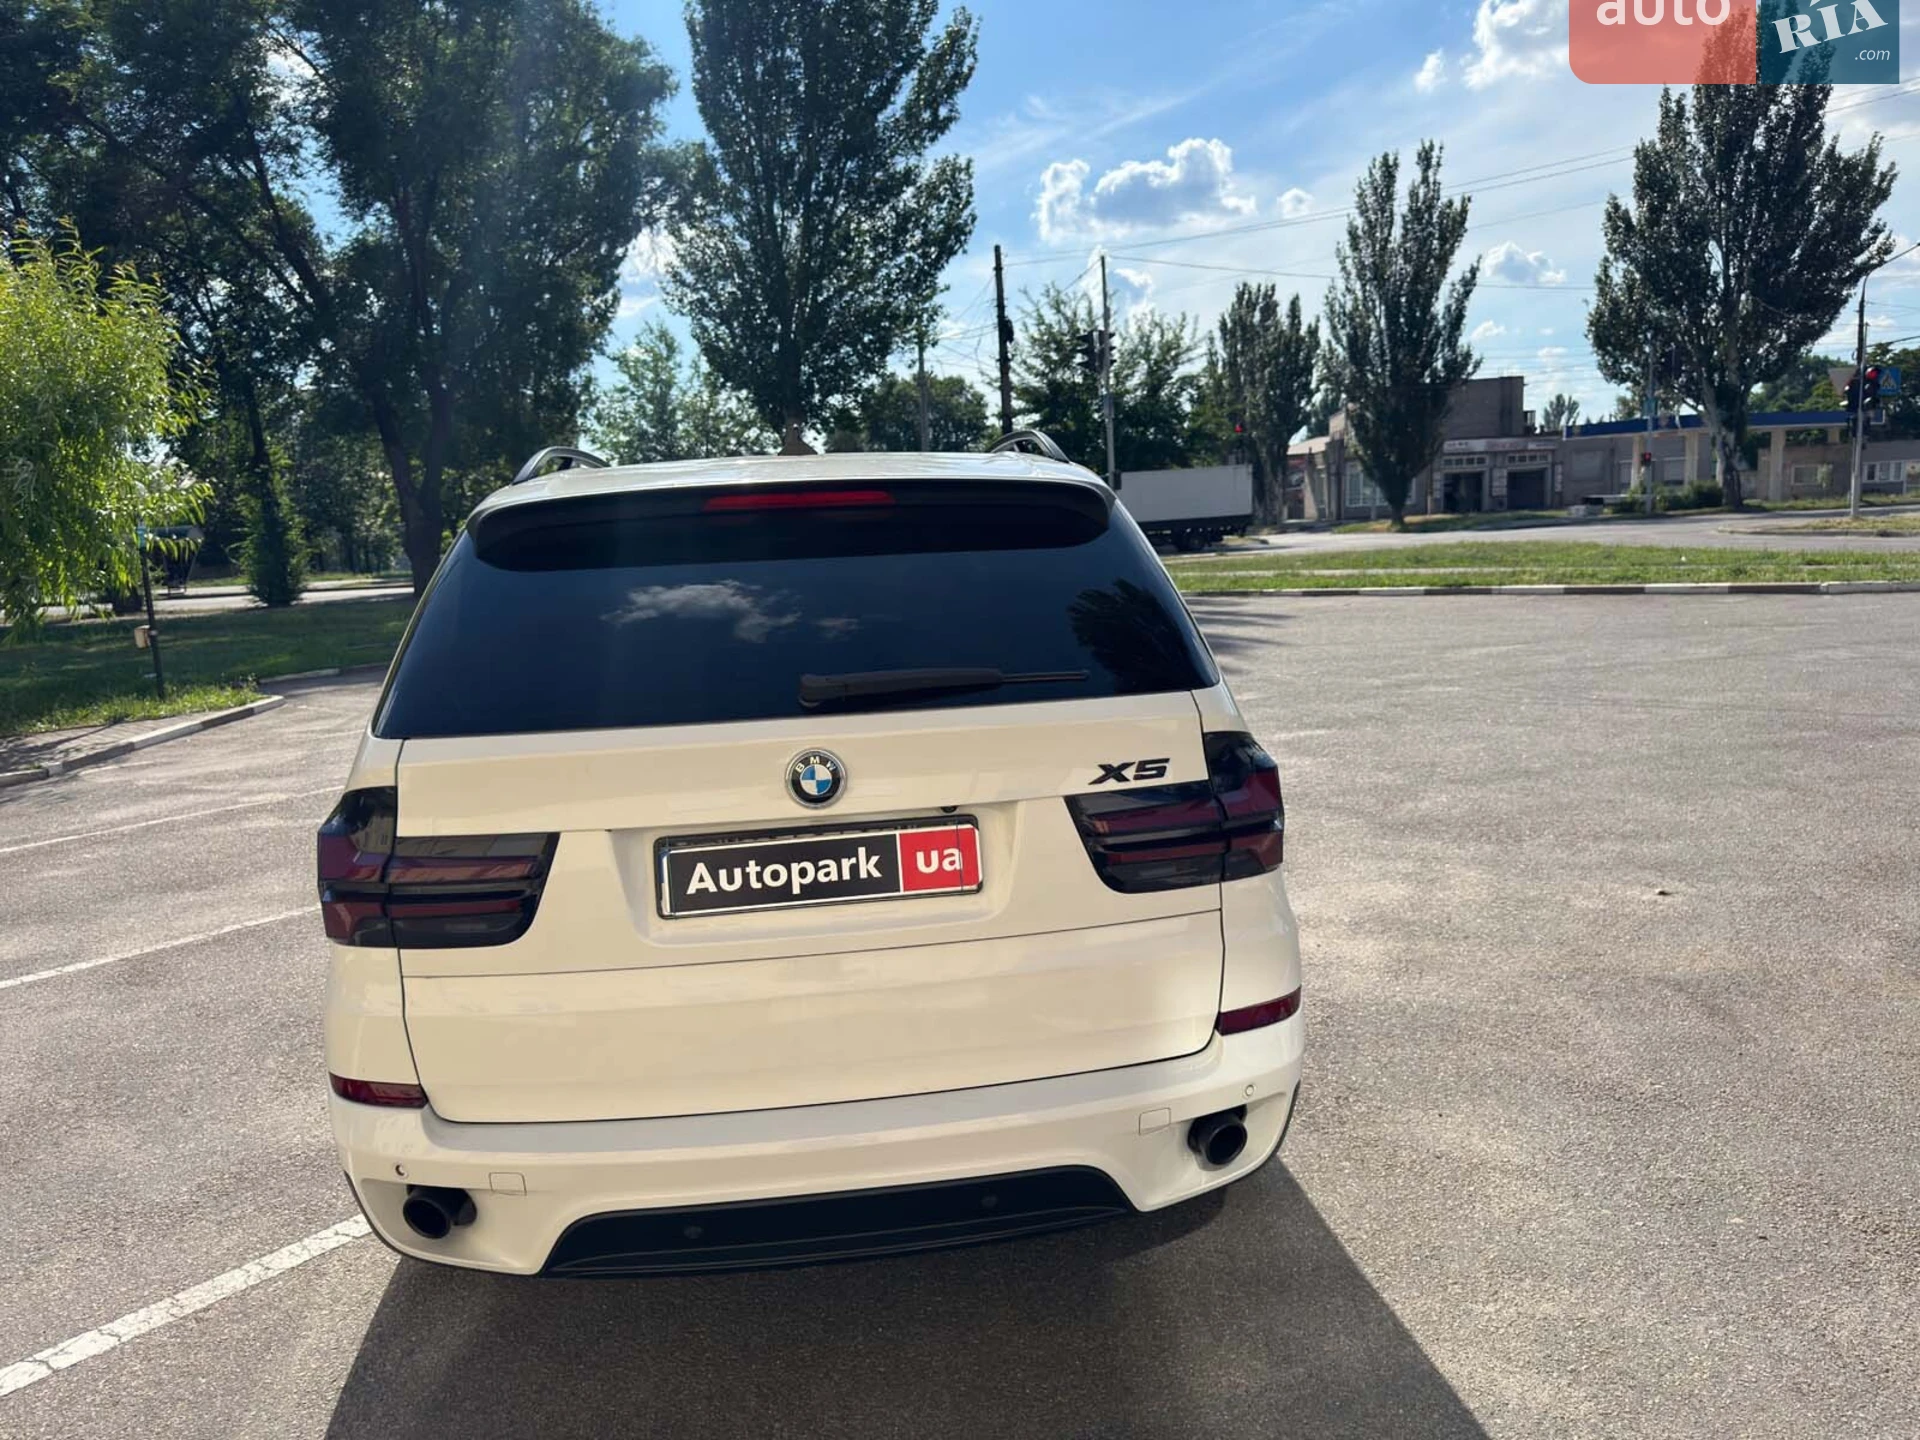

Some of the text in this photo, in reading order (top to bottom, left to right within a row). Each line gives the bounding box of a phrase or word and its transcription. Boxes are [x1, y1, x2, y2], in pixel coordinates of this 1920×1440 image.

[795, 755, 837, 773] BMW
[1087, 757, 1171, 786] X5
[686, 846, 963, 895] Autopark ua
